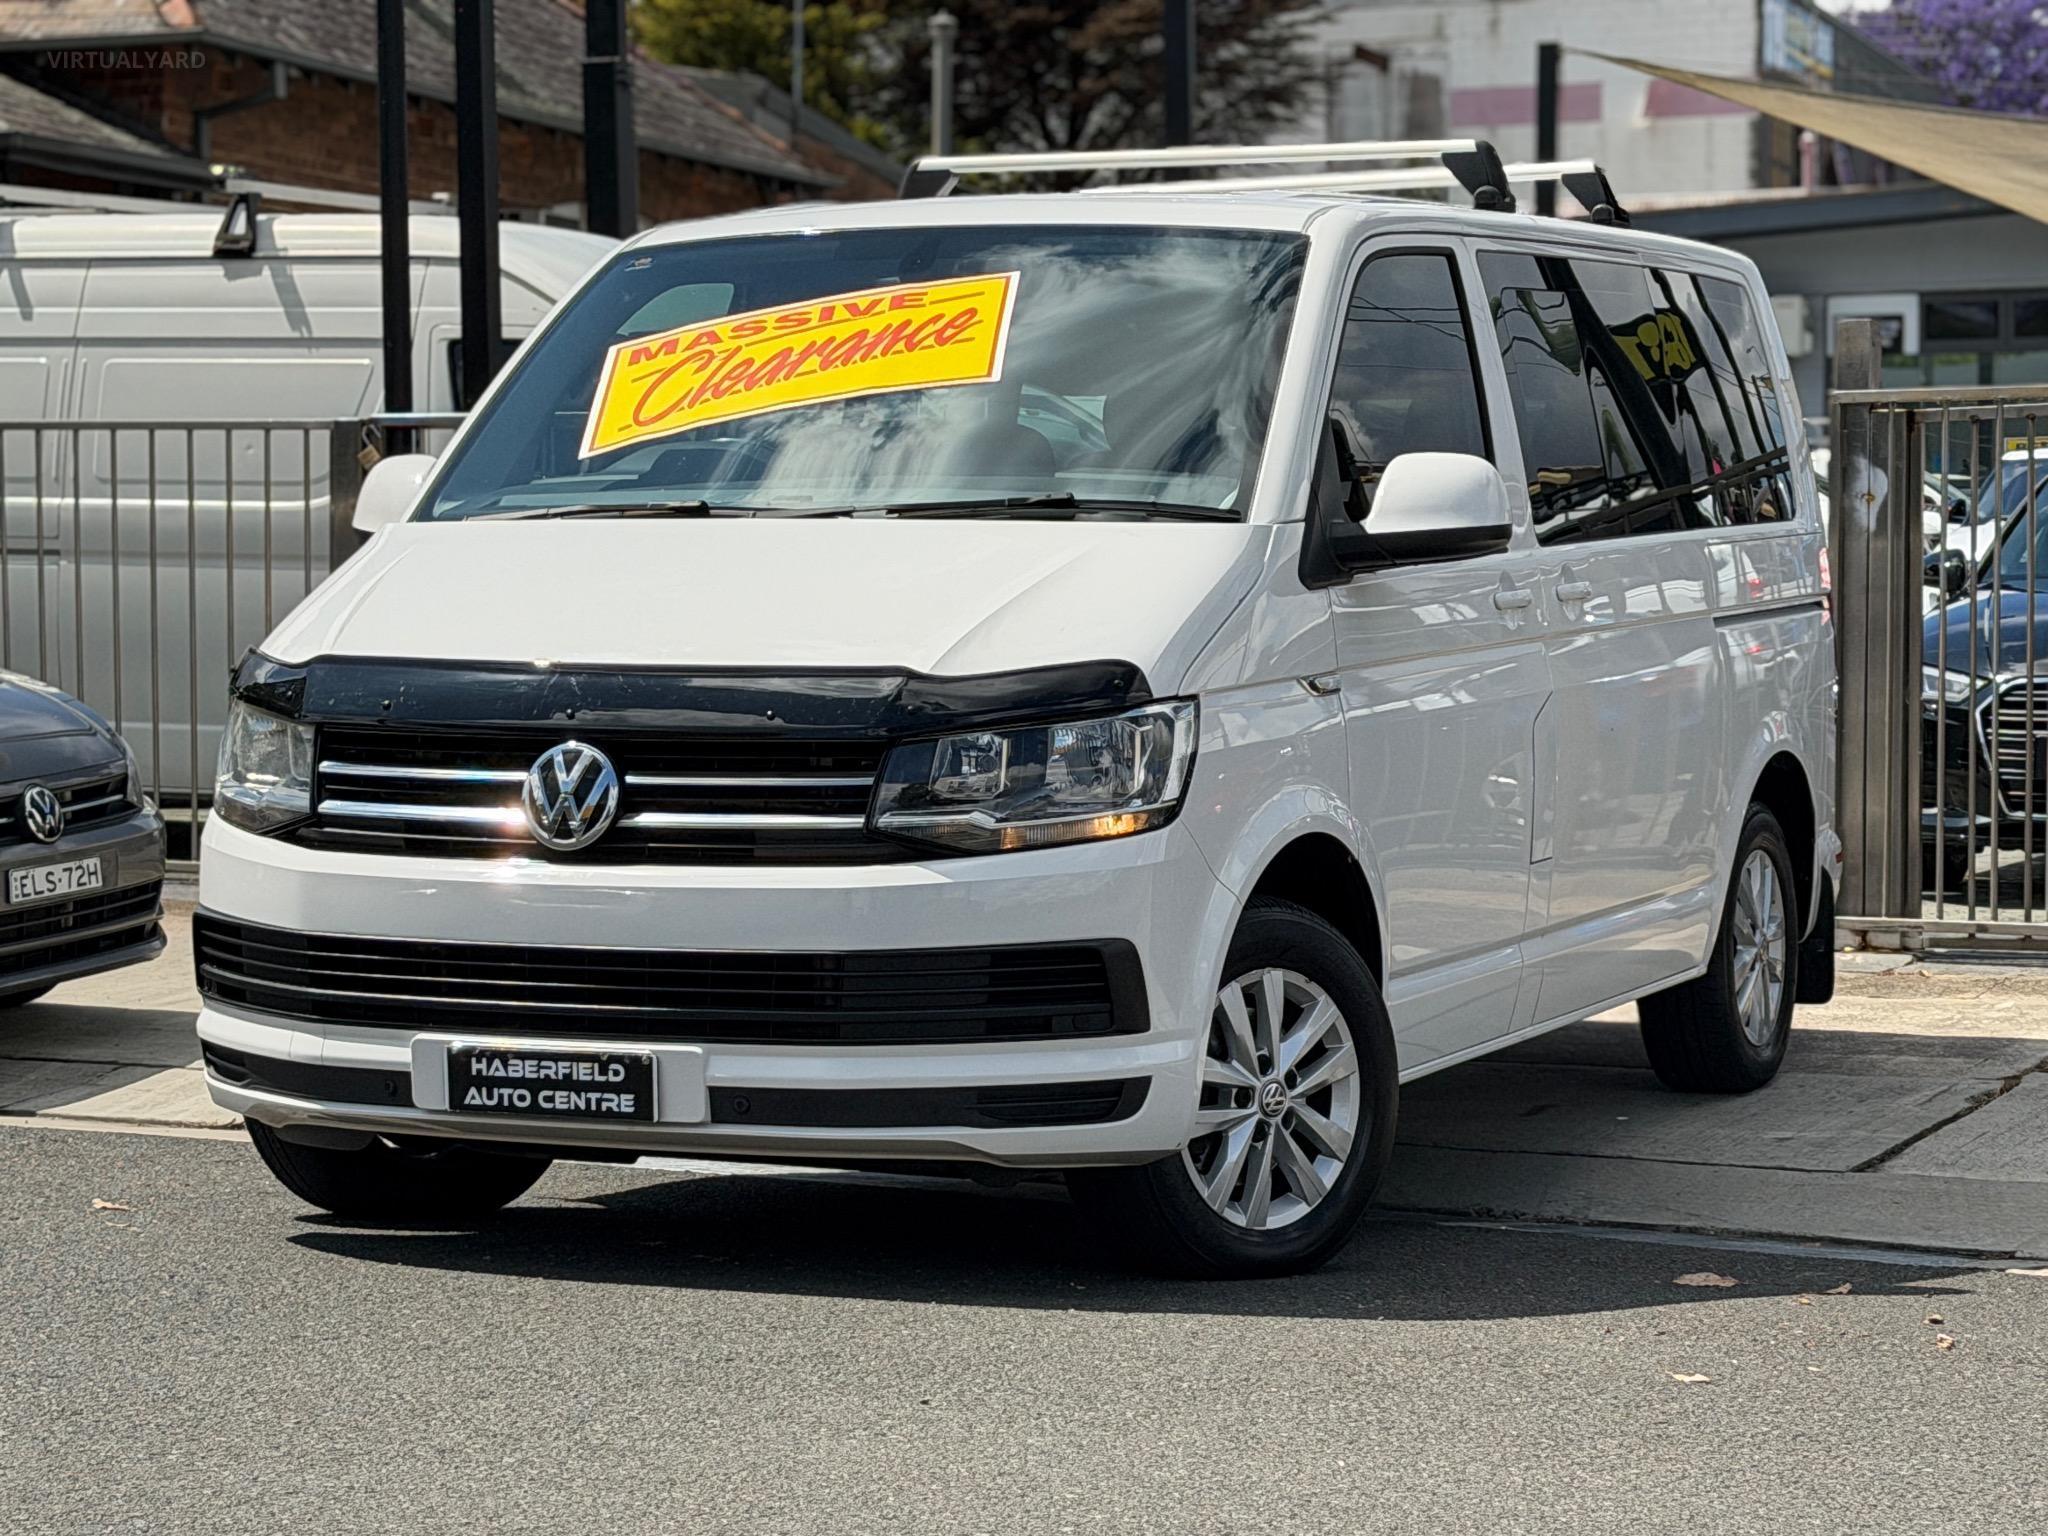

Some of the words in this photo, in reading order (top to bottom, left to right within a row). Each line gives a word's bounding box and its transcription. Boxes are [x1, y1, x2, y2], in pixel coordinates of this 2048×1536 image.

[628, 291, 929, 366] MASSIVE
[632, 306, 979, 427] Clearance
[527, 745, 615, 842] VW
[464, 1086, 532, 1108] AUTO
[538, 1090, 636, 1113] CENTRE
[471, 1057, 625, 1083] HABERFIELD
